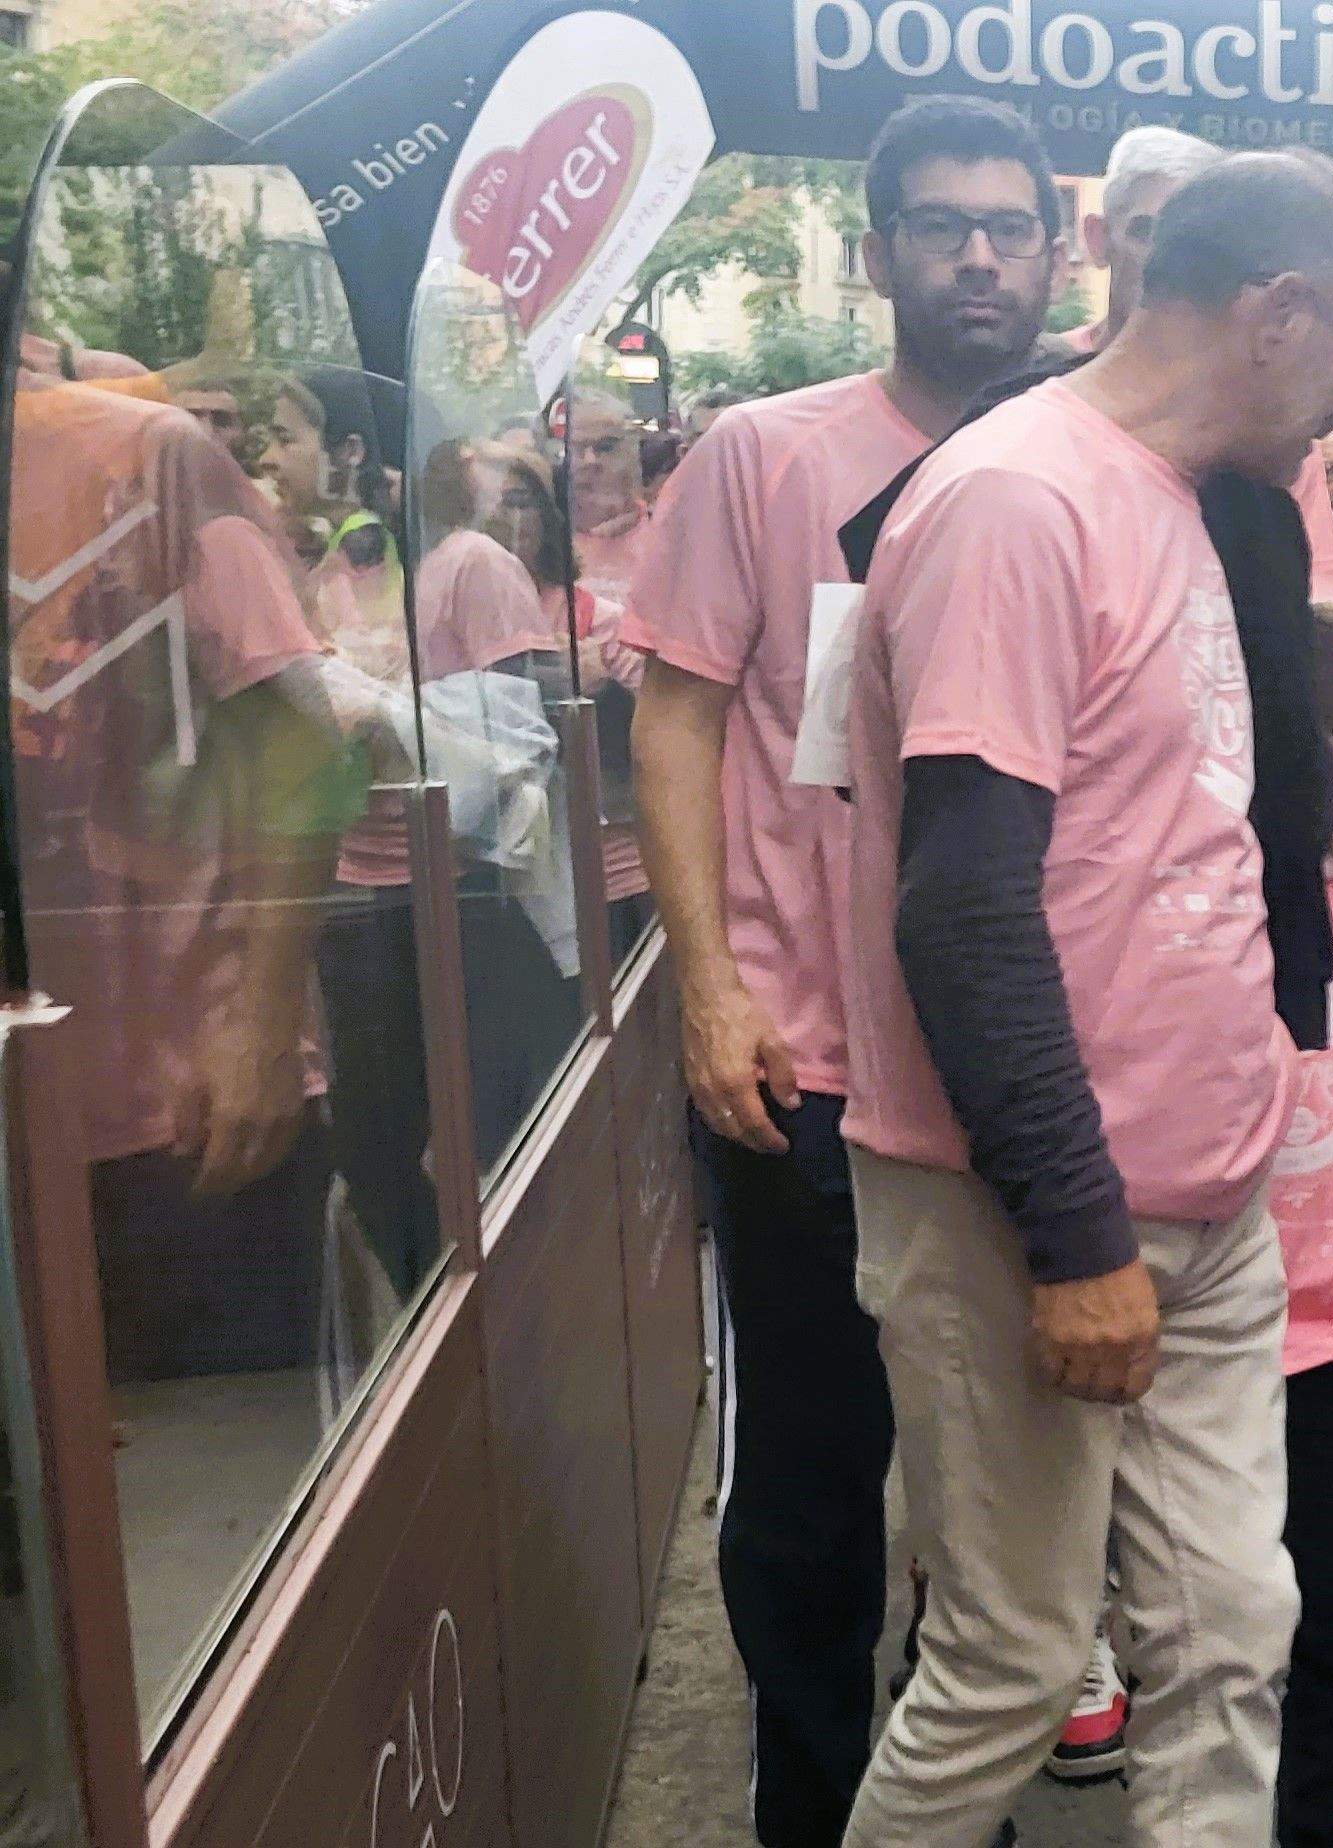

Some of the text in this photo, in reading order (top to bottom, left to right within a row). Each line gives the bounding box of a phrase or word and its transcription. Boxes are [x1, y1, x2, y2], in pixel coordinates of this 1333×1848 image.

[351, 122, 449, 190] bien
[463, 166, 508, 226] 1876
[498, 111, 621, 298] errer
